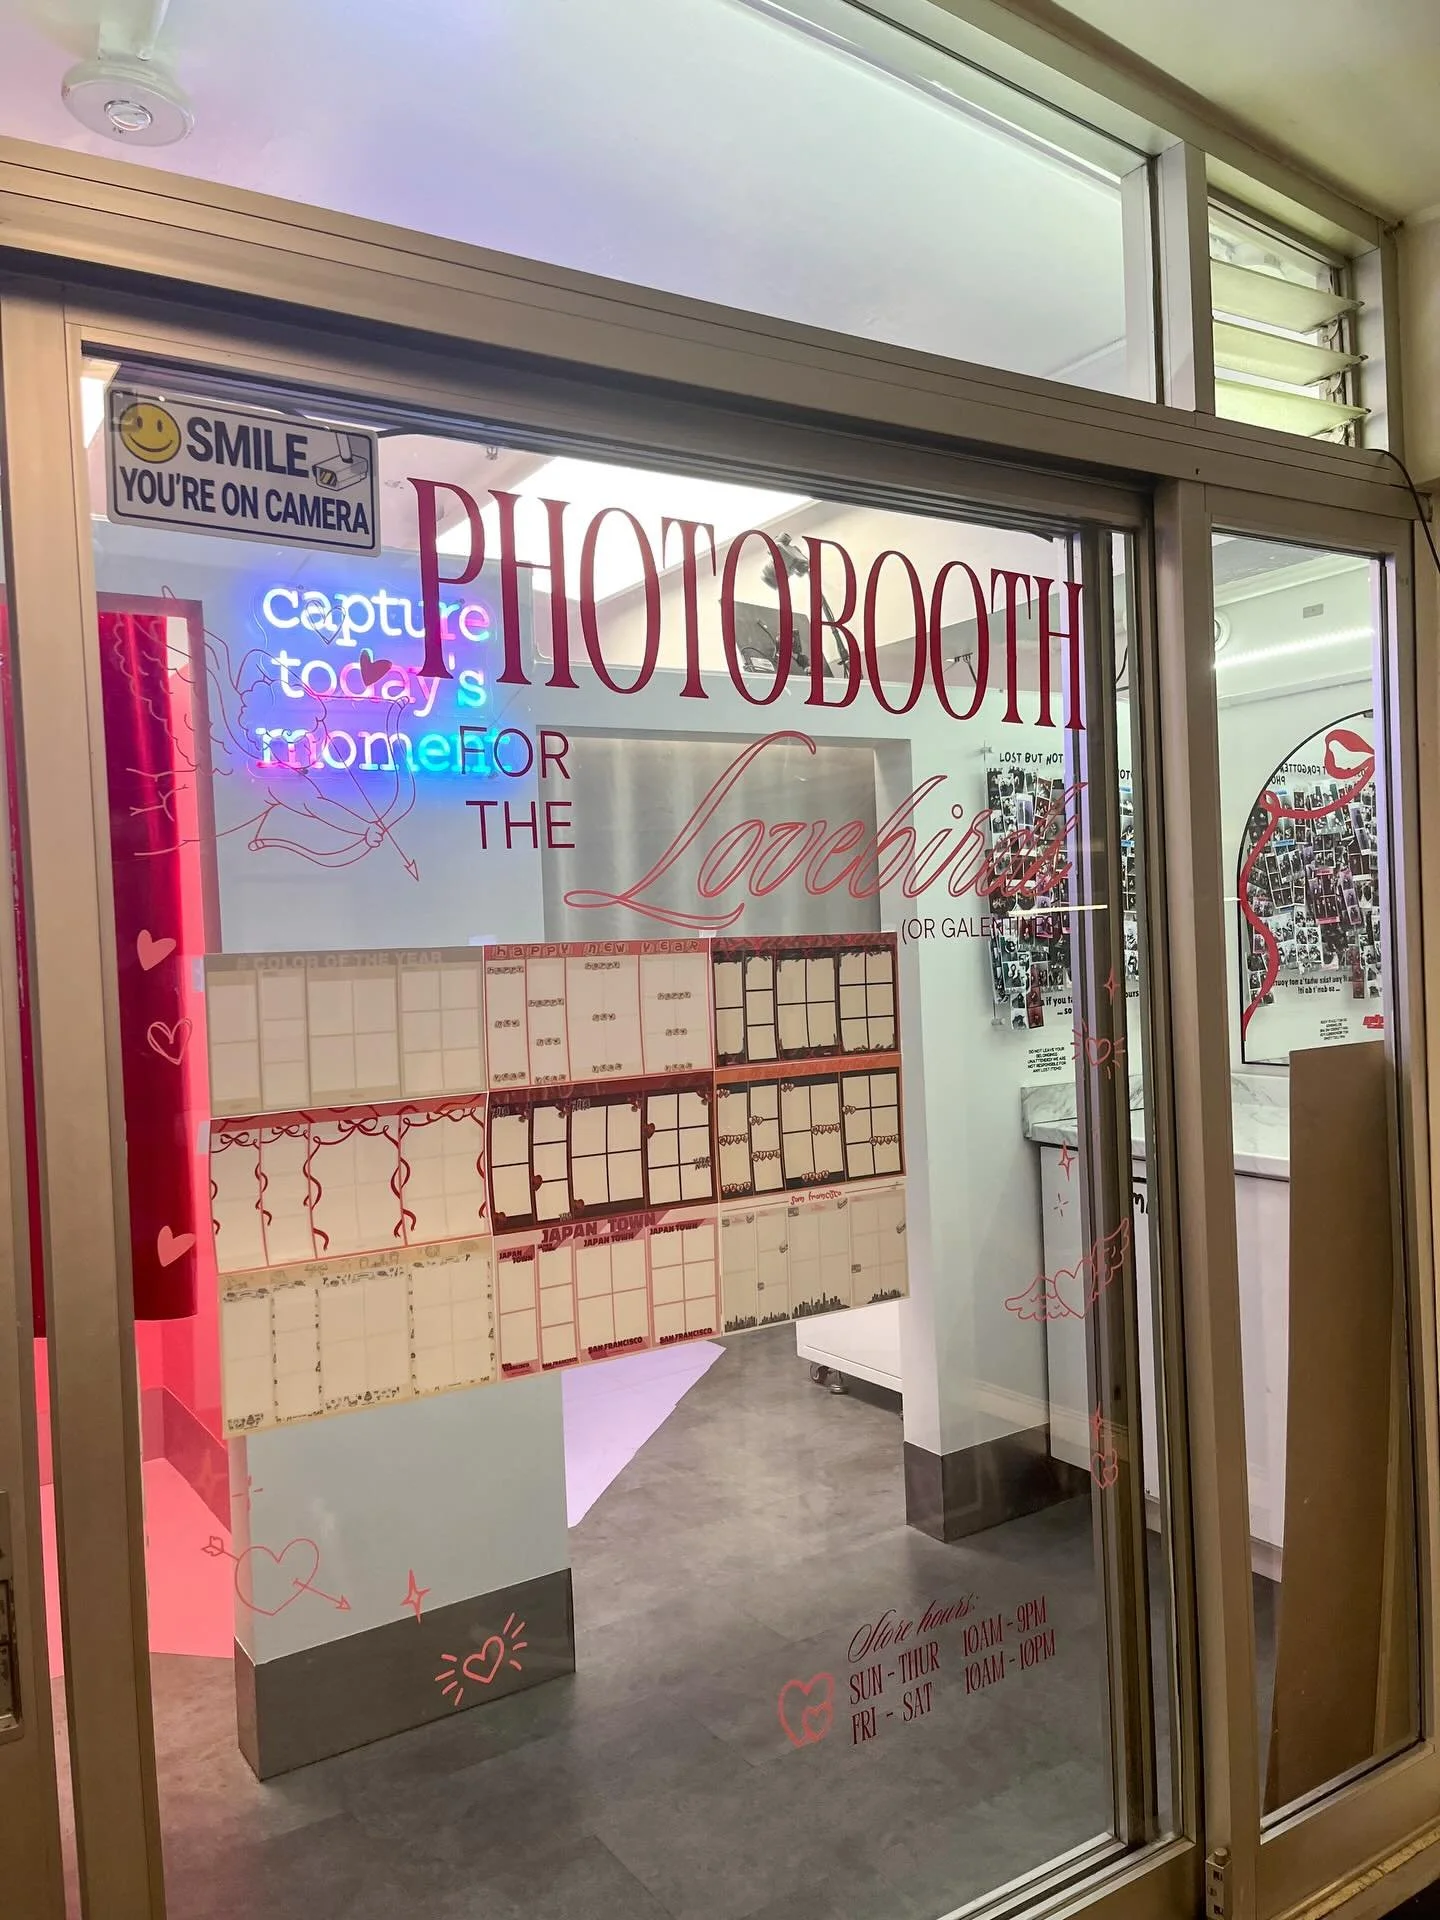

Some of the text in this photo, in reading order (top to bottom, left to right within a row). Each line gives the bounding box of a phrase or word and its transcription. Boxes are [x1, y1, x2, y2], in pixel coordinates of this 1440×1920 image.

[186, 416, 310, 479] SMILE
[120, 465, 371, 536] YOU'RE ON CAMERA
[406, 477, 1087, 731] PHOTOBOOTH
[255, 725, 512, 775] moment
[457, 725, 571, 781] FOR
[1000, 752, 1063, 765] LOST BUT NOT
[465, 800, 575, 850] THE
[902, 918, 935, 944] (OR
[253, 955, 319, 970] COLOR
[353, 953, 389, 967] THE
[396, 951, 442, 965] YEAR
[1053, 997, 1066, 1007] you
[1125, 990, 1139, 998] ours
[541, 1212, 656, 1244] JAPAN TOWN
[583, 1235, 610, 1248] JAPAN
[650, 1226, 675, 1236] JAPAN
[604, 1337, 643, 1351] FRANCISCO
[675, 1328, 713, 1341] FRANCISCO
[848, 1592, 979, 1663] Store hours:
[850, 1664, 883, 1705] SUN
[898, 1641, 940, 1684] THUR
[963, 1614, 1003, 1656] 10AM
[1017, 1596, 1046, 1634] 9PM
[852, 1706, 877, 1746] FRI
[903, 1682, 933, 1722] SAT
[964, 1651, 1005, 1694] 10AM
[1019, 1629, 1056, 1671] 10PM
